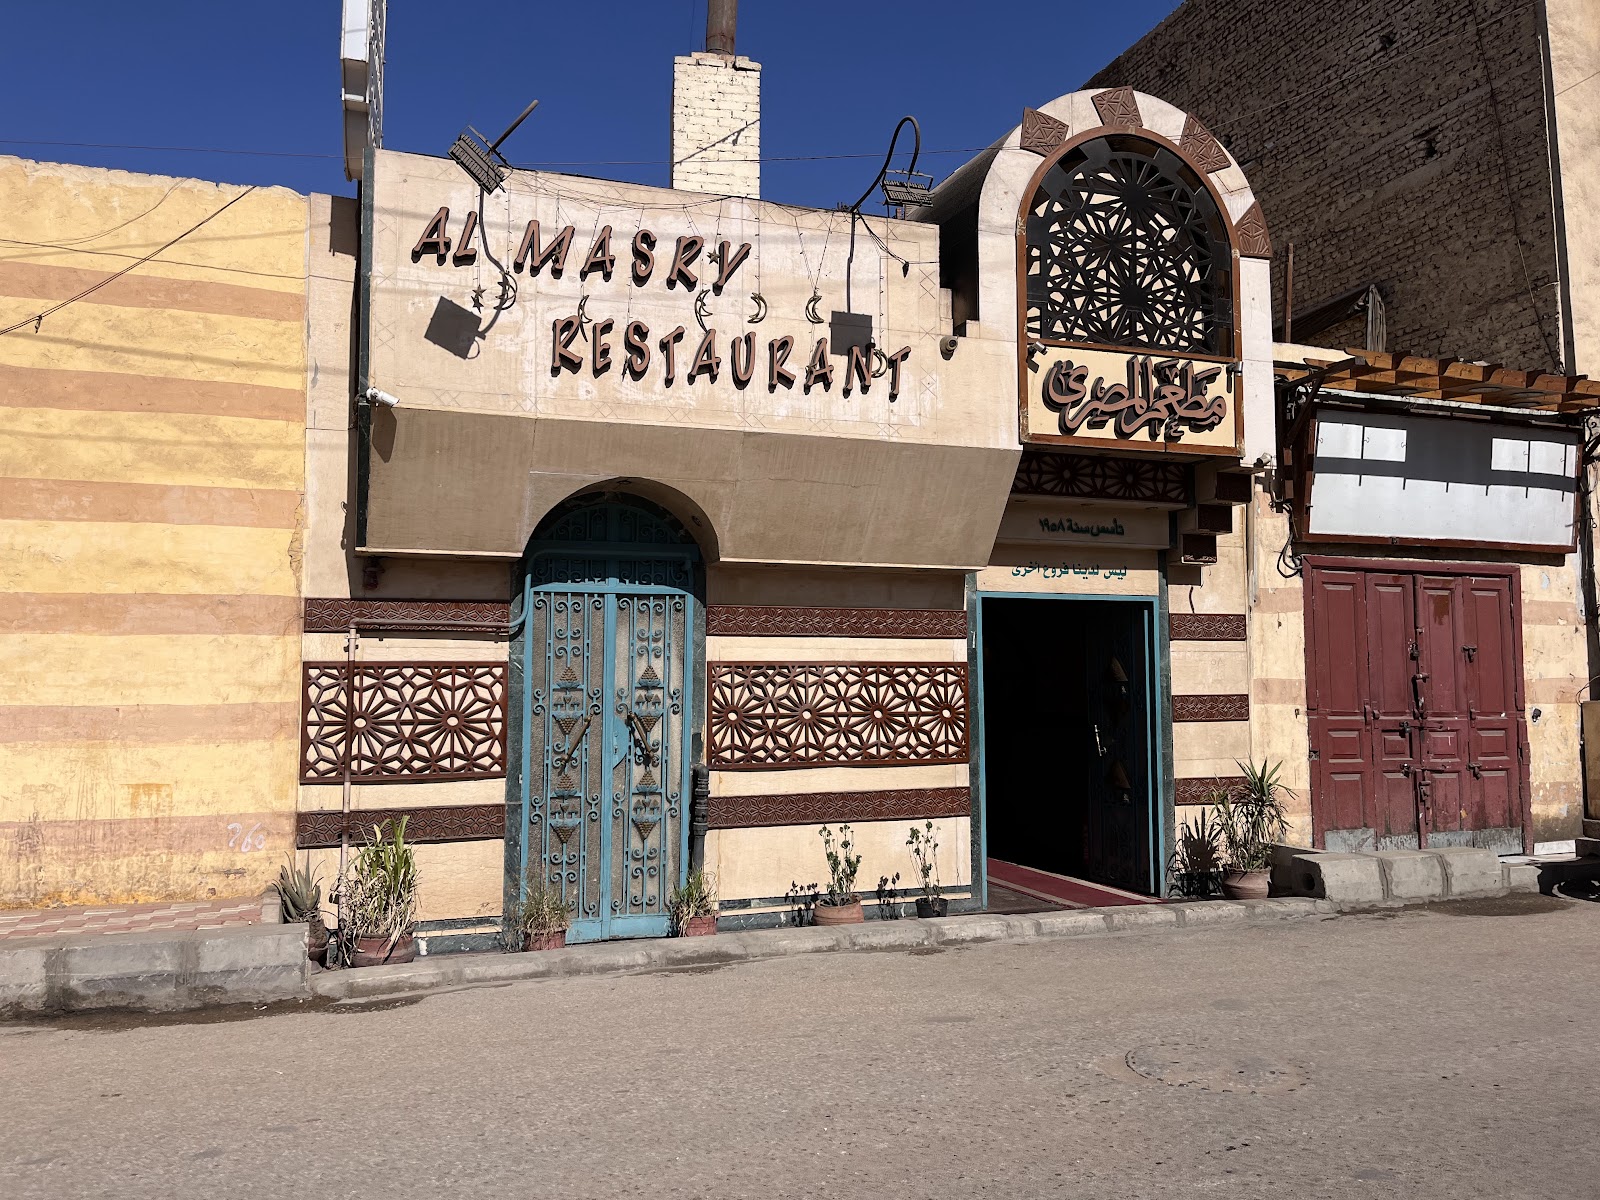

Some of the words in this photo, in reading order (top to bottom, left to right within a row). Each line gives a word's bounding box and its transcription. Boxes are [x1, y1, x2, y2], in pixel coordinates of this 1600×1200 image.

[411, 206, 479, 267] AL
[514, 219, 752, 293] MASRY
[551, 314, 911, 402] RESTAURANT
[1043, 562, 1070, 579] فروع
[1072, 563, 1100, 579] لدينا
[1103, 565, 1128, 580] ليس
